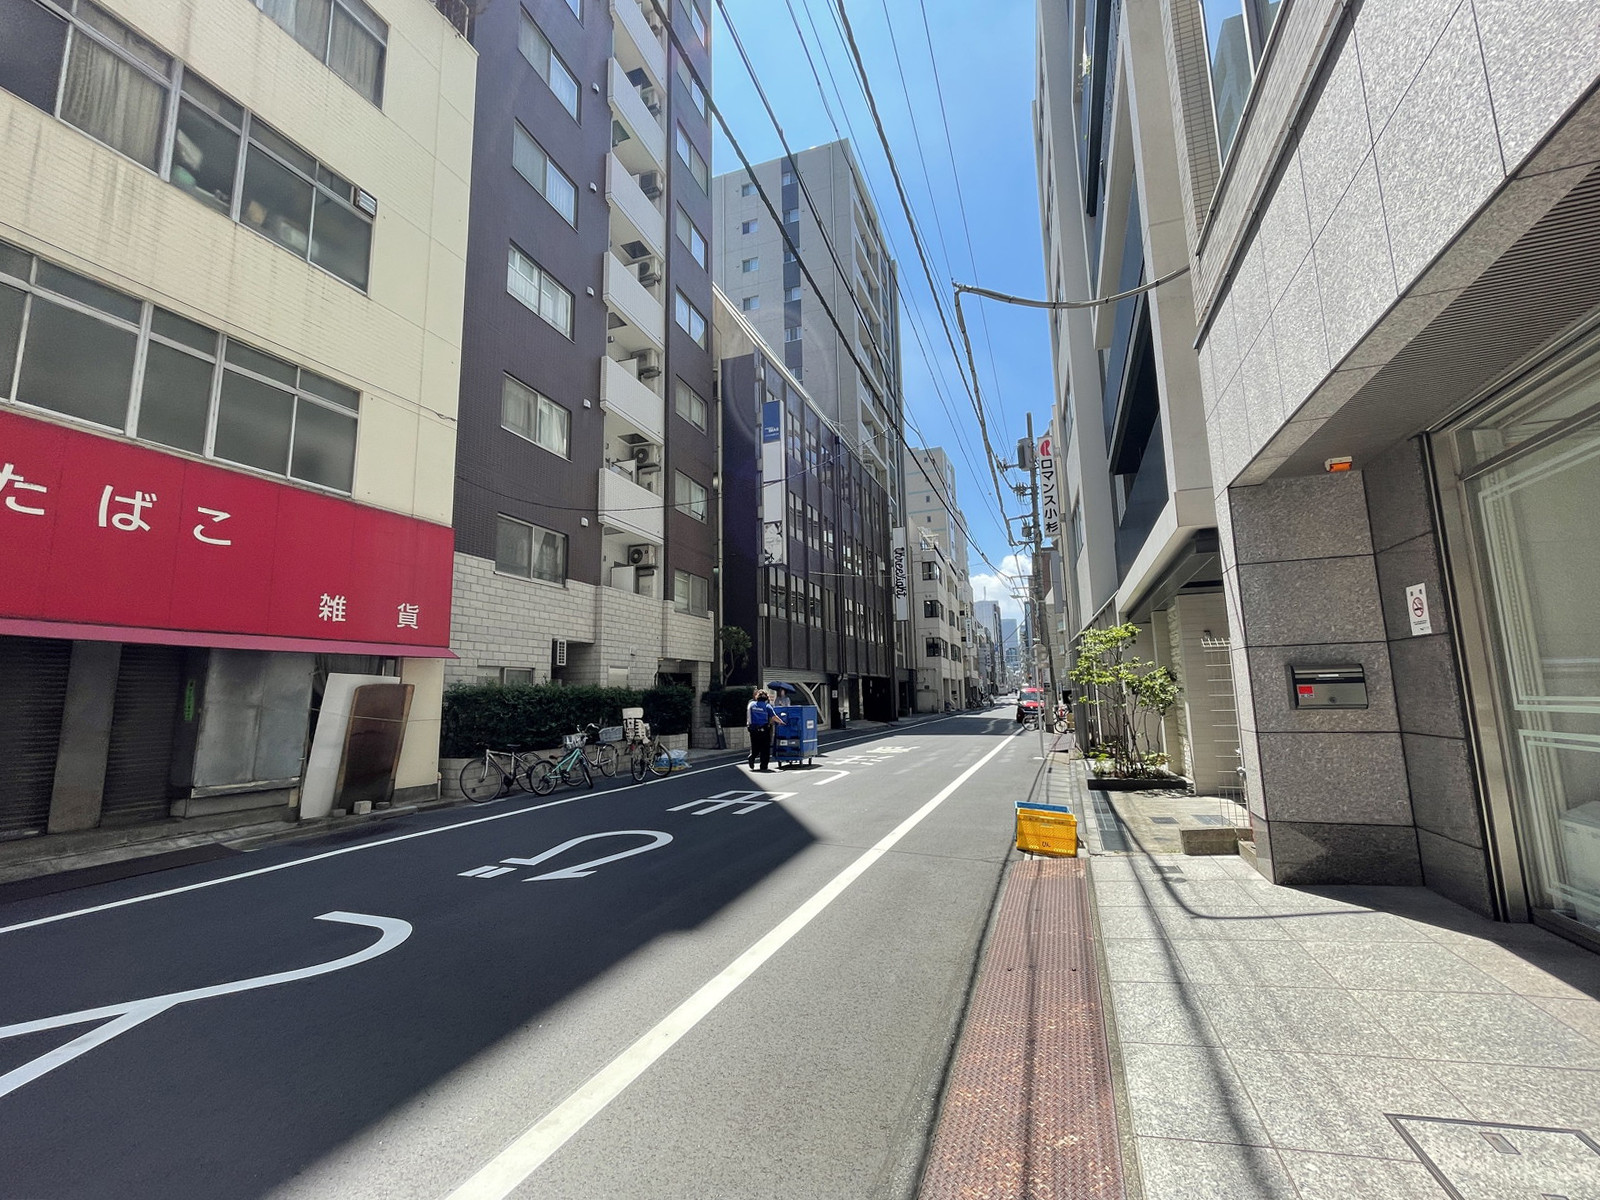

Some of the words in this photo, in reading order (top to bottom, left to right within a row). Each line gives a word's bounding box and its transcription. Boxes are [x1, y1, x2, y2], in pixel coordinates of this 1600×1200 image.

[0, 463, 232, 546] たばこ
[1041, 458, 1058, 533] ロマンス小杉
[318, 592, 420, 629] 雑貨
